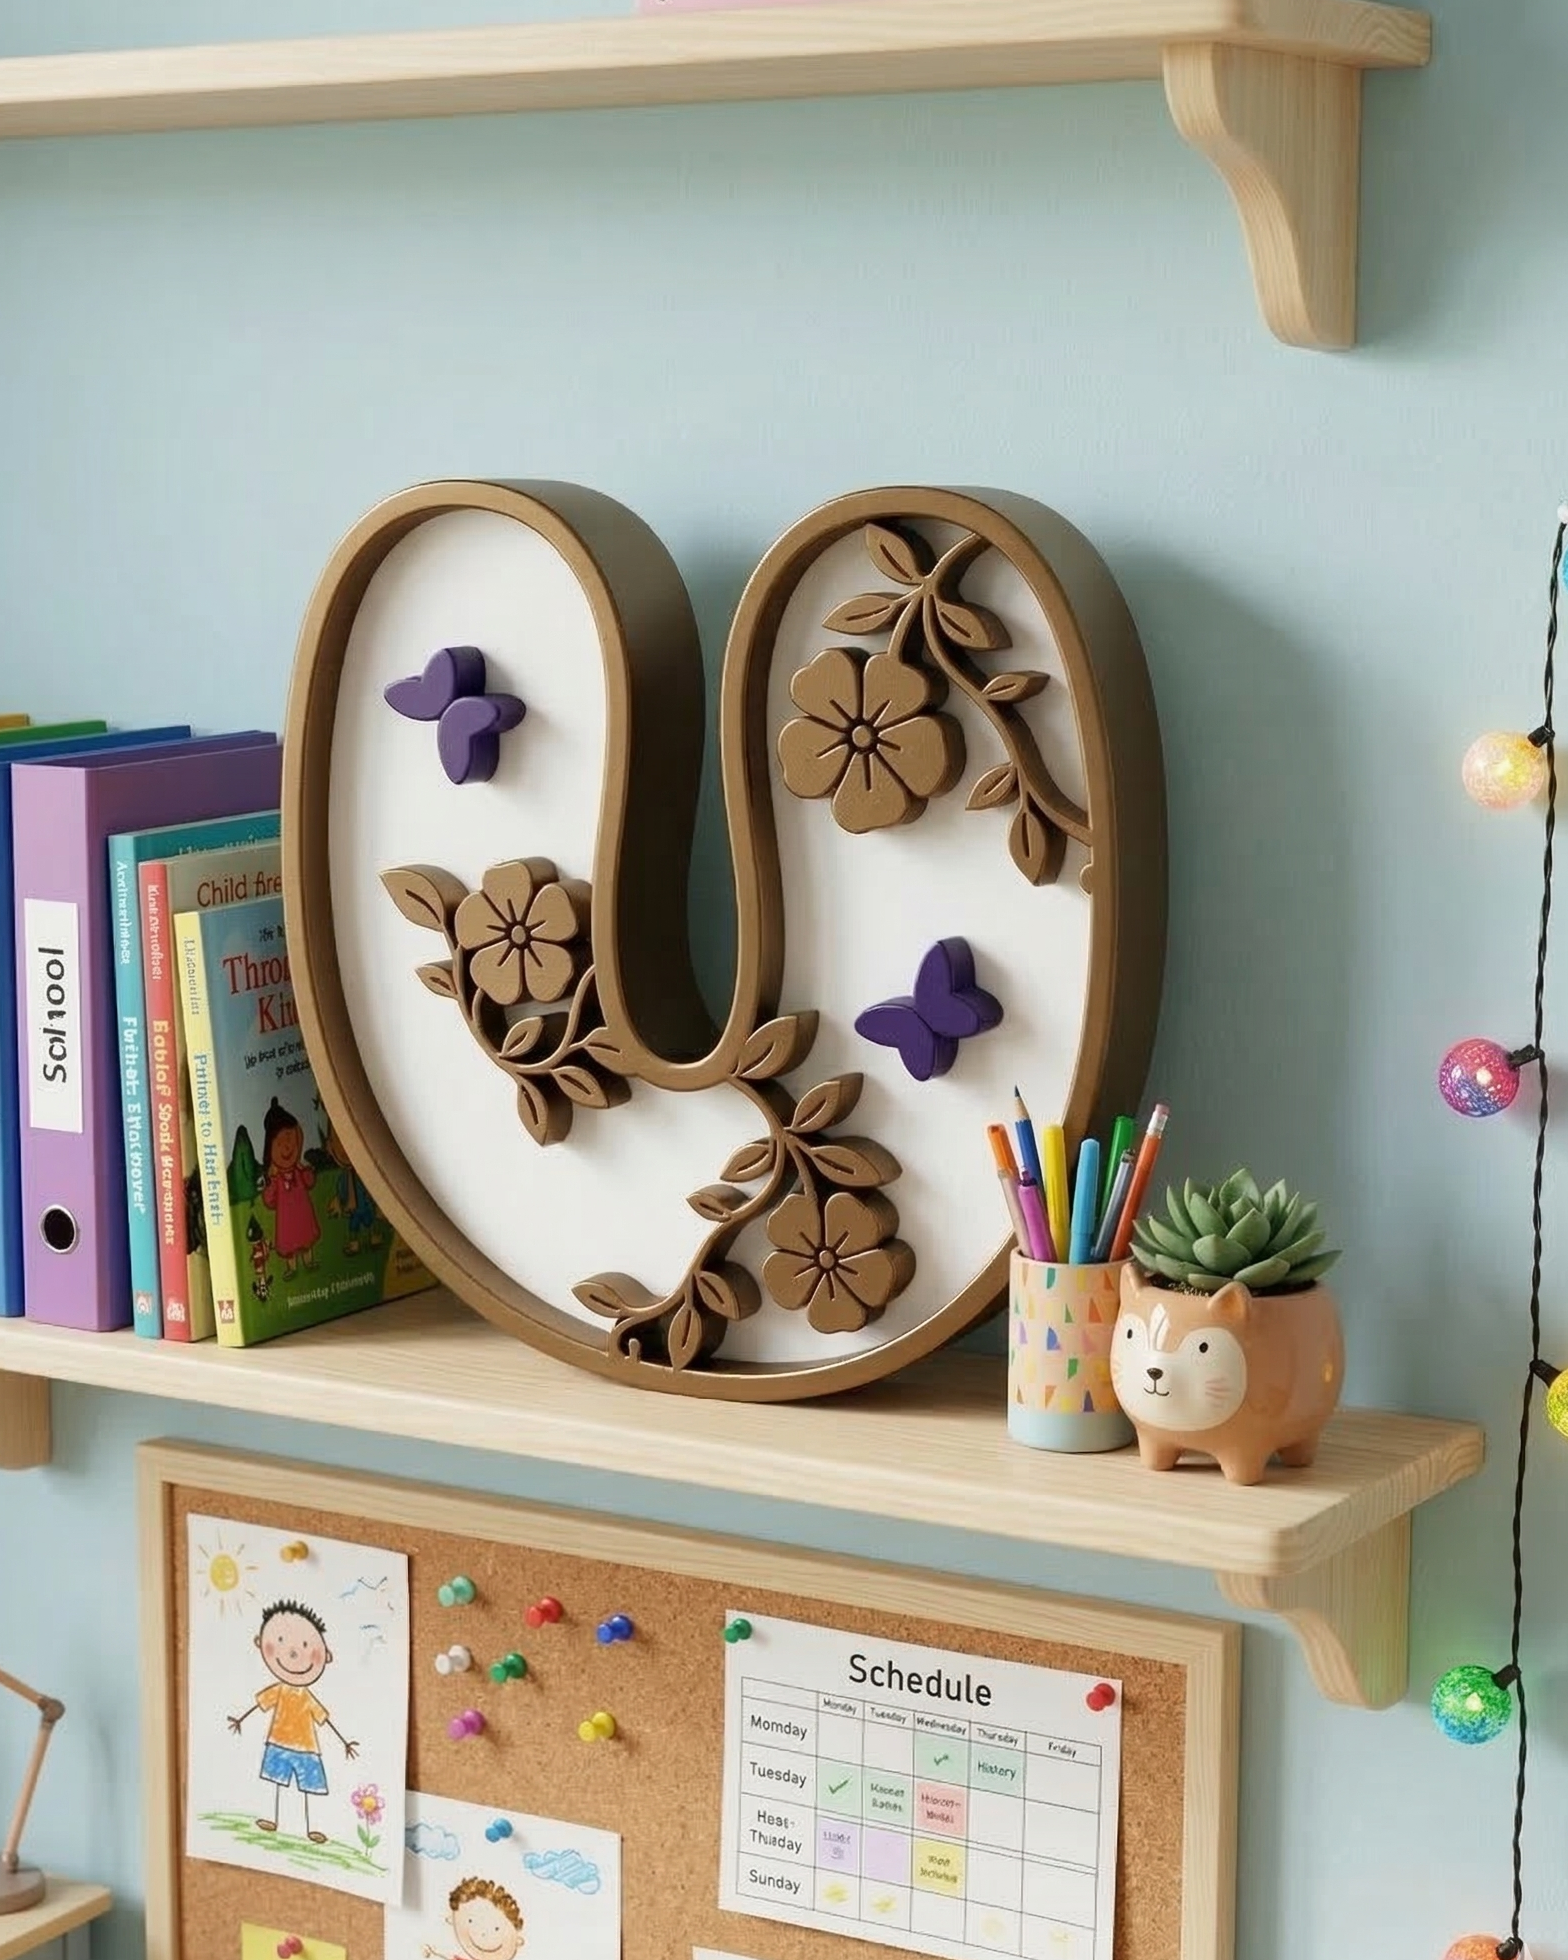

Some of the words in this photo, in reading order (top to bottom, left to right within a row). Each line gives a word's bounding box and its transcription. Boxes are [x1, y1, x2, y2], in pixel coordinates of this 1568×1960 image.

[196, 873, 248, 908] Child
[848, 1653, 992, 1707] Schedule
[750, 1714, 808, 1742] Momday
[976, 1727, 1019, 1748] Thursday
[749, 1760, 807, 1789] Tuesday
[748, 1868, 802, 1895] Sunday
